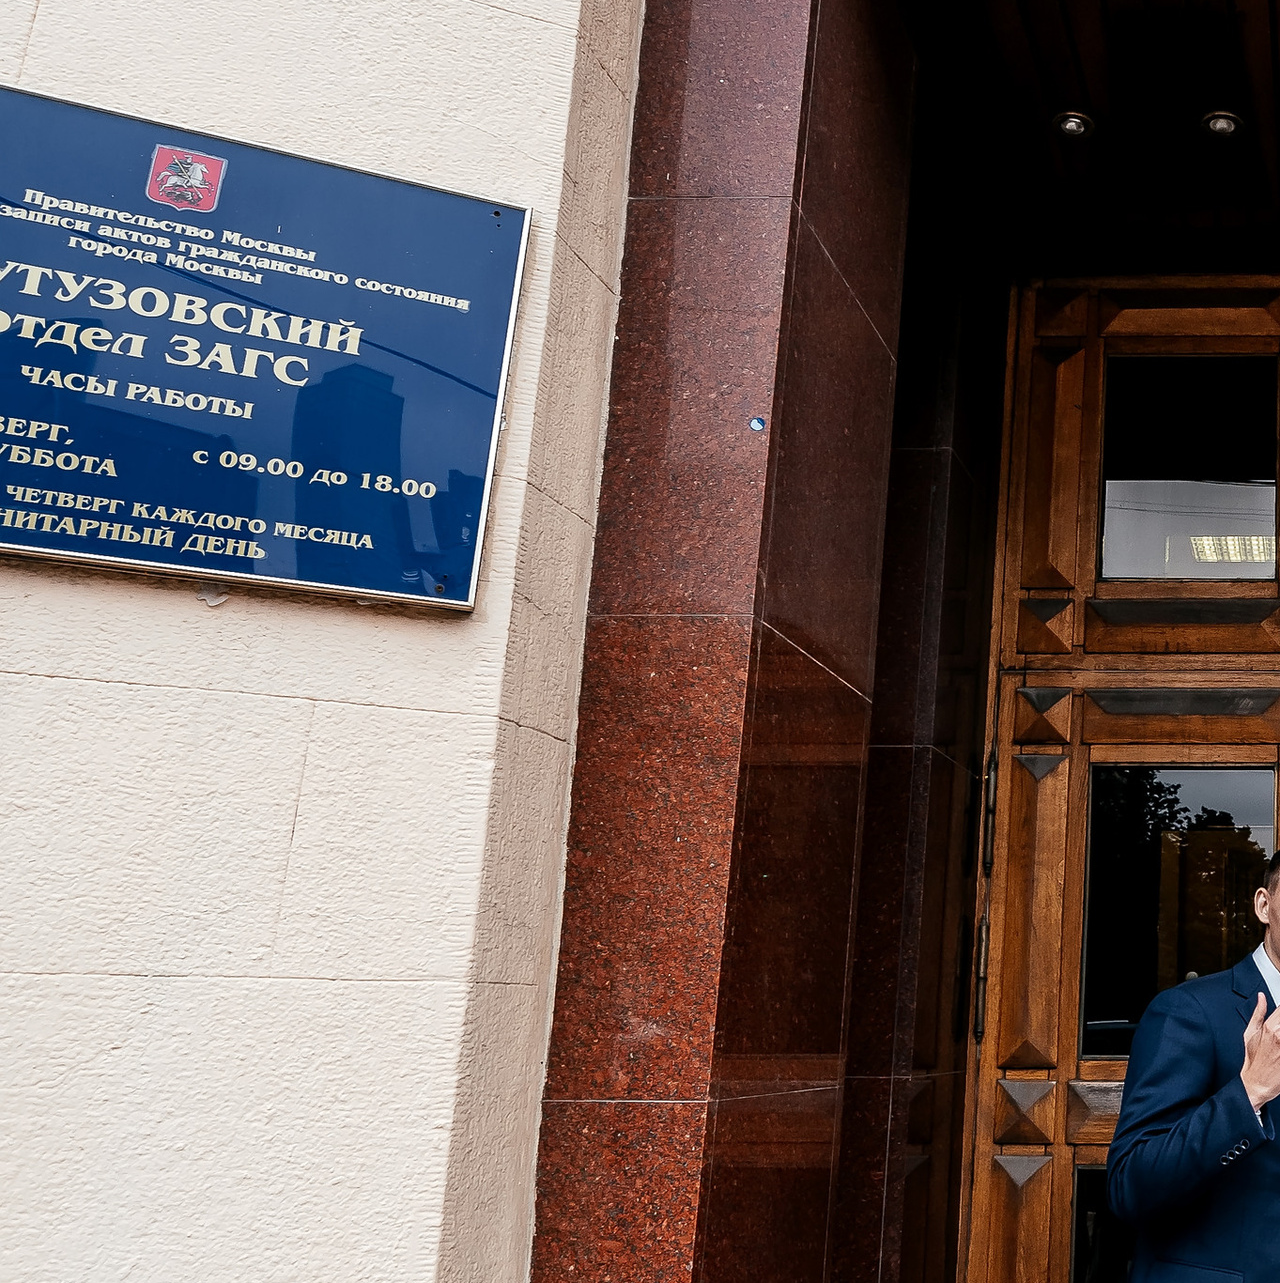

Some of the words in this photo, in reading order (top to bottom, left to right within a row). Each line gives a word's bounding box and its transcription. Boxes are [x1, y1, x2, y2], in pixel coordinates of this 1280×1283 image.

[23, 189, 215, 240] Правительство
[221, 230, 316, 262] Москвы
[0, 205, 92, 232] записи
[97, 225, 172, 248] актов
[177, 241, 349, 284] гражданского
[355, 278, 470, 310] состояния
[68, 236, 157, 264] города
[165, 253, 263, 284] Москвы
[165, 334, 309, 387] ЗАГС
[21, 365, 118, 397] ЧАСЫ
[125, 383, 254, 419] РАБОТЫ
[0, 416, 74, 445] ЕРГ,
[219, 451, 304, 478] 09.00
[309, 469, 347, 486] до
[360, 473, 436, 498] 18.00
[7, 485, 125, 514] ЧЕТВЕРГ
[131, 502, 266, 534] КАЖДОГО
[273, 522, 373, 550] МЕСЯЦА
[180, 534, 265, 559] ДЕНЬ
